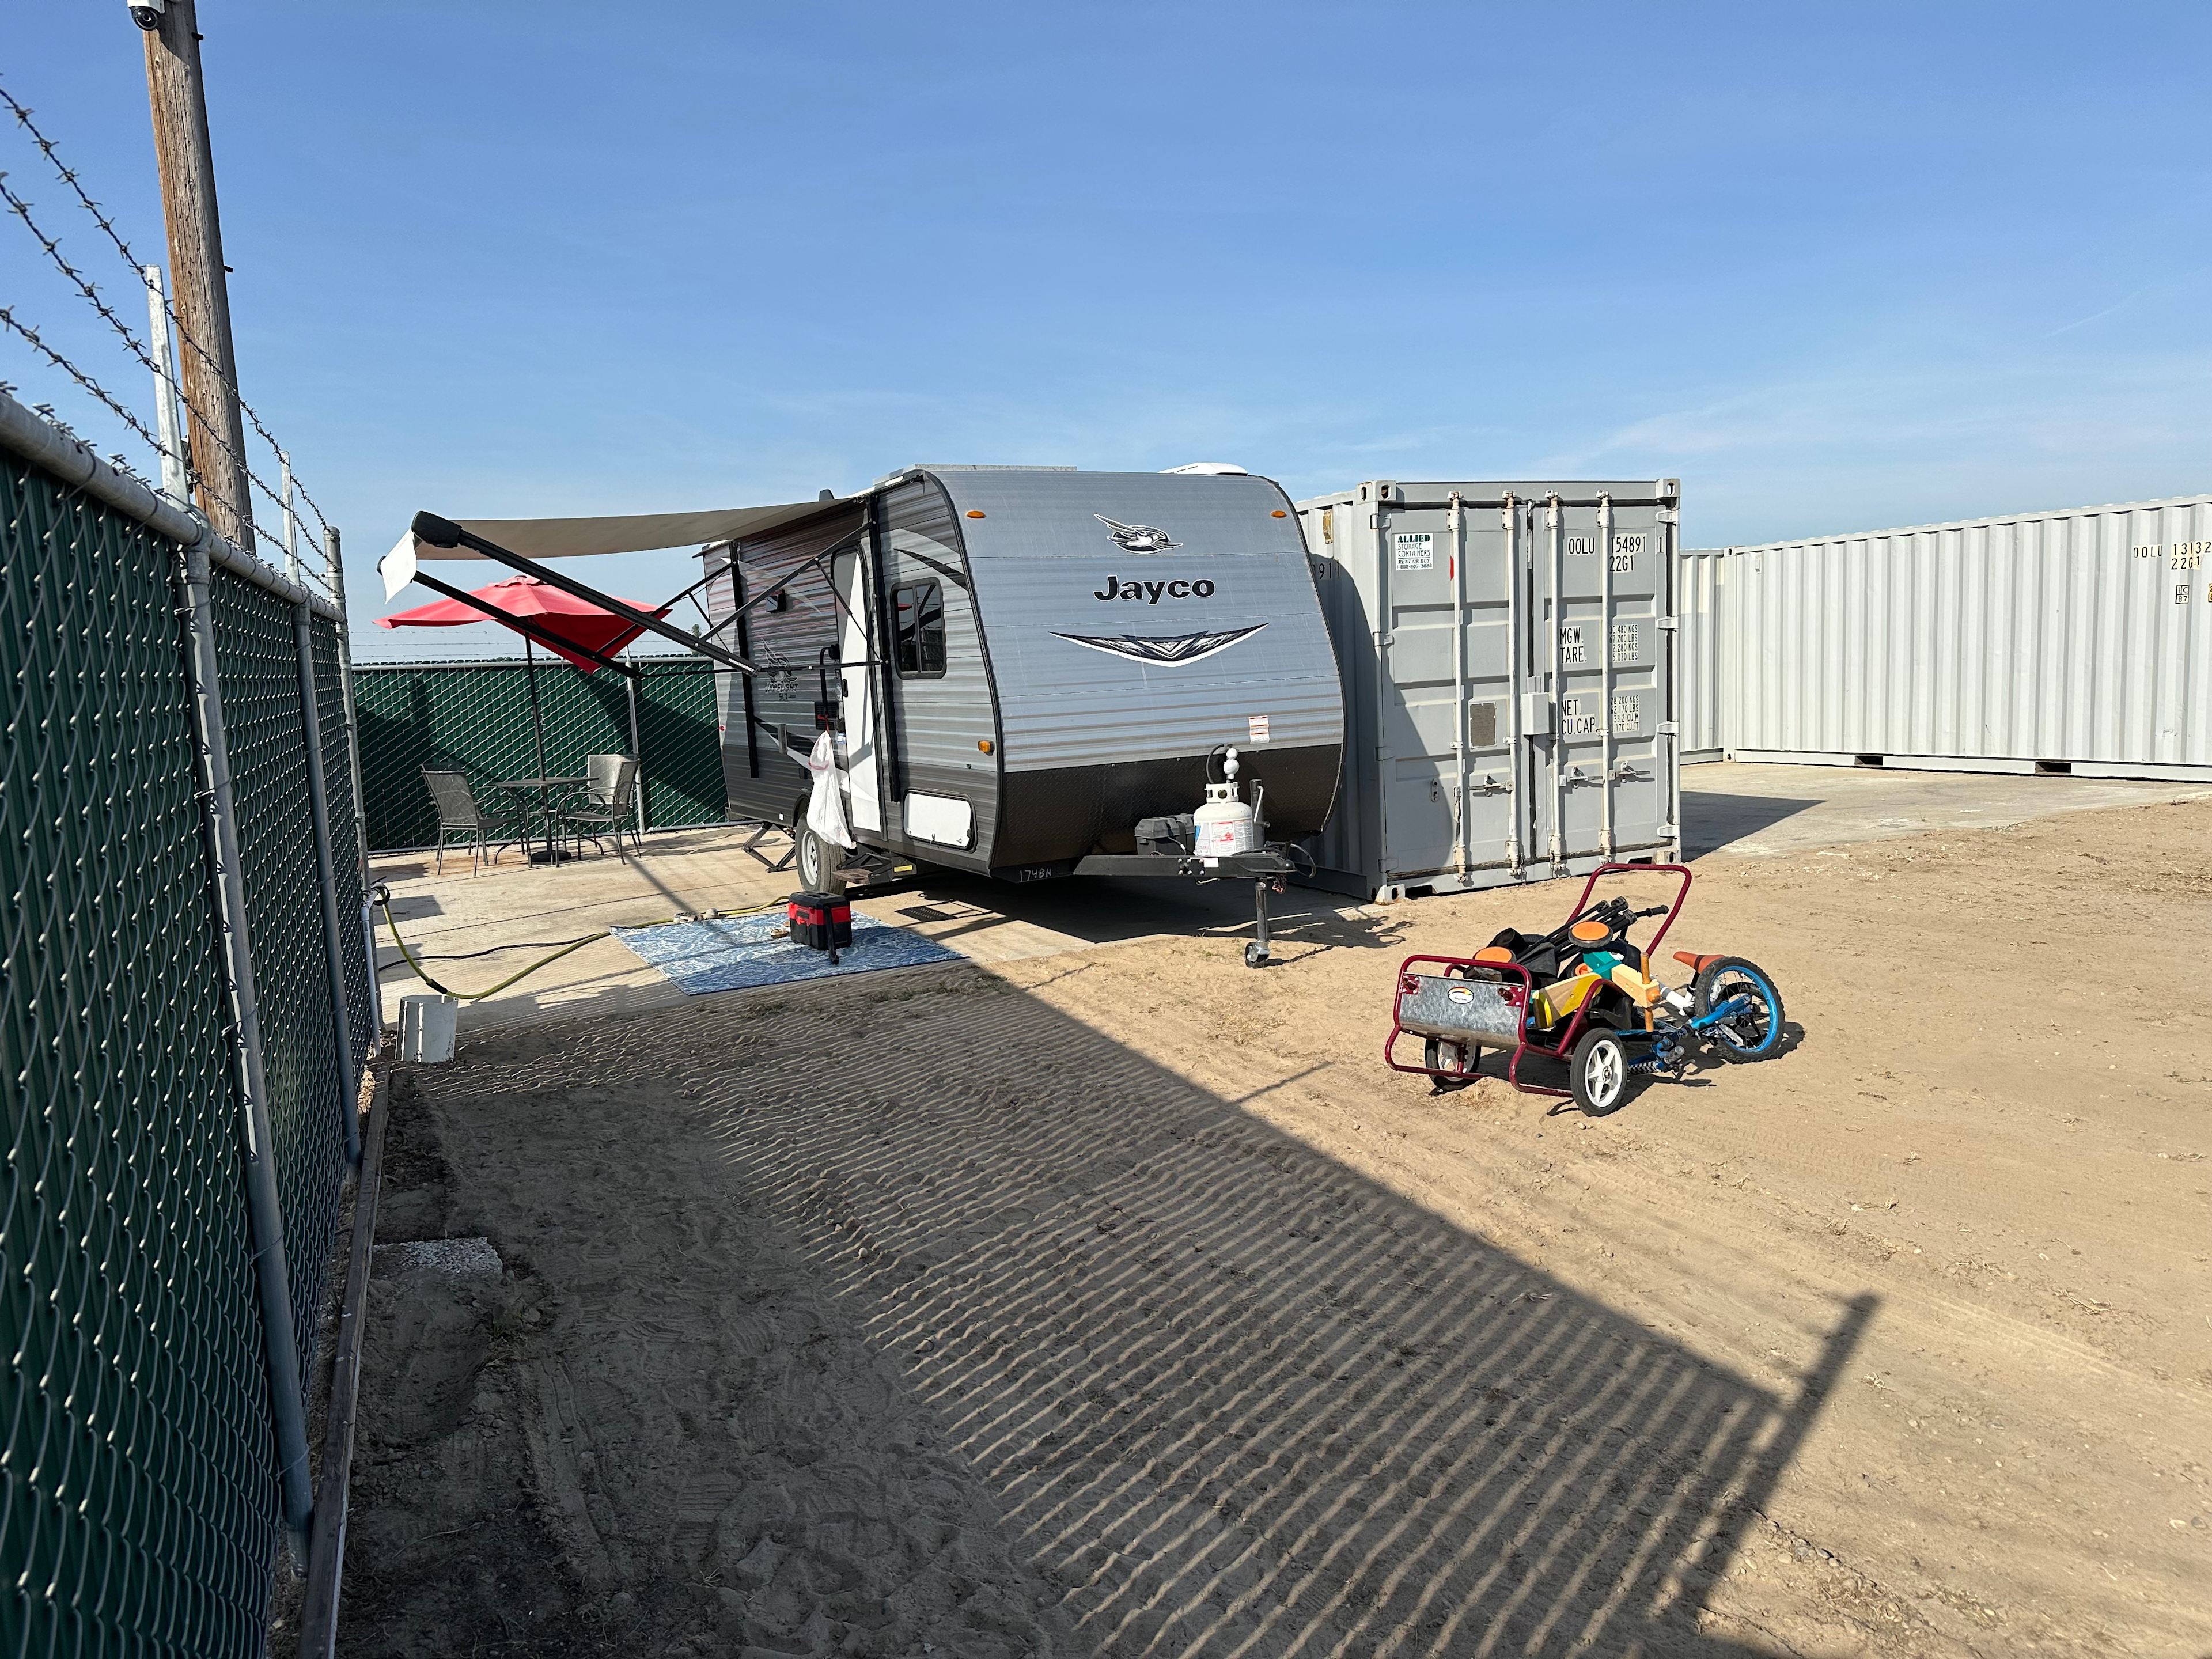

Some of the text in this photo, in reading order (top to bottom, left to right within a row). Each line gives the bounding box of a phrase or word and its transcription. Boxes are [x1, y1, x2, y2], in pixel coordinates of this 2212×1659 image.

[1397, 535, 1430, 543] ALLIED
[1609, 555, 1634, 572] 22G1
[2171, 556, 2200, 570] 22G1
[1093, 575, 1217, 605] Jayco
[1628, 624, 1638, 633] KGS
[1628, 634, 1638, 642] LBS
[1628, 643, 1638, 652] KGS
[1628, 652, 1638, 661] LBS
[1629, 695, 1639, 703] KGS
[1629, 704, 1639, 713] LBS
